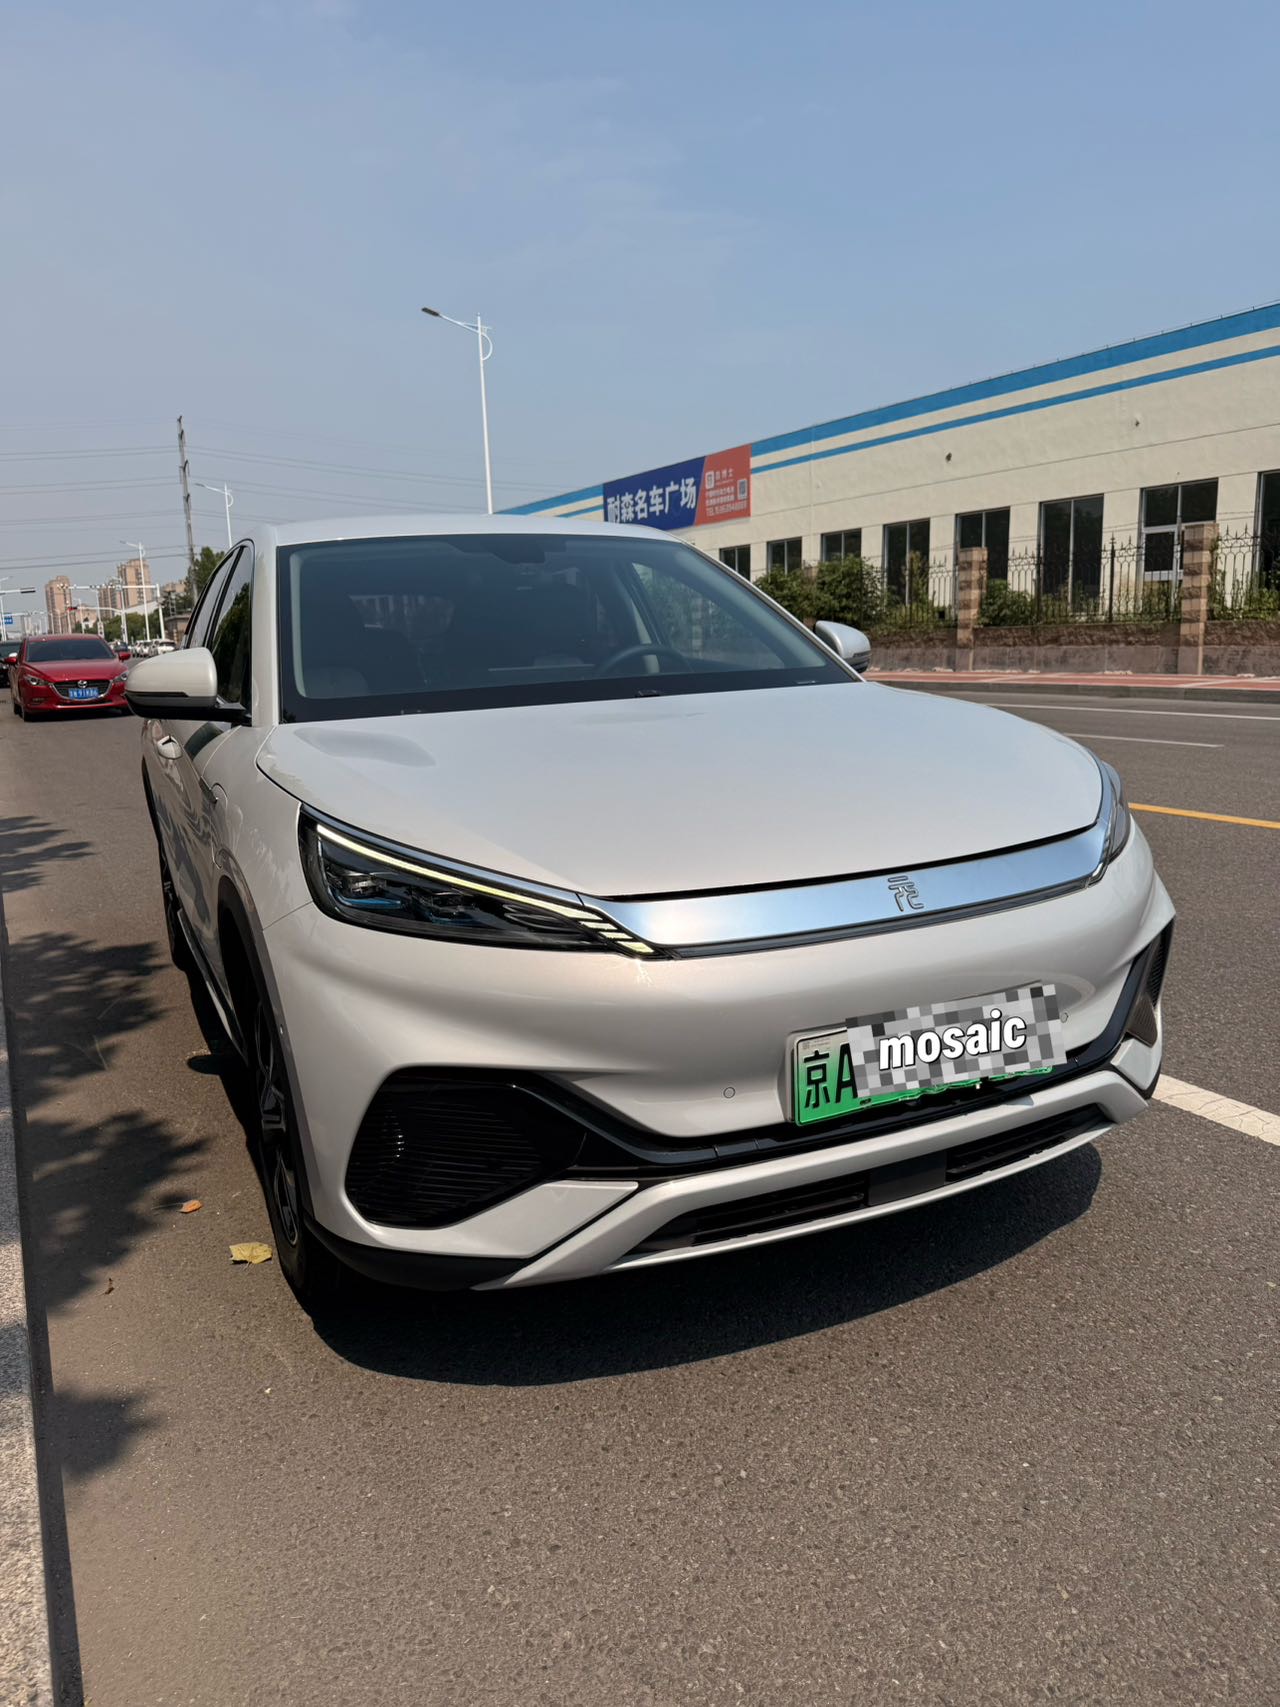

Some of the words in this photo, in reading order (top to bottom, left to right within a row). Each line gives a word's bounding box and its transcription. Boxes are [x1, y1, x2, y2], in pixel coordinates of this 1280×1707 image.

[606, 477, 697, 524] 耐森名车广场
